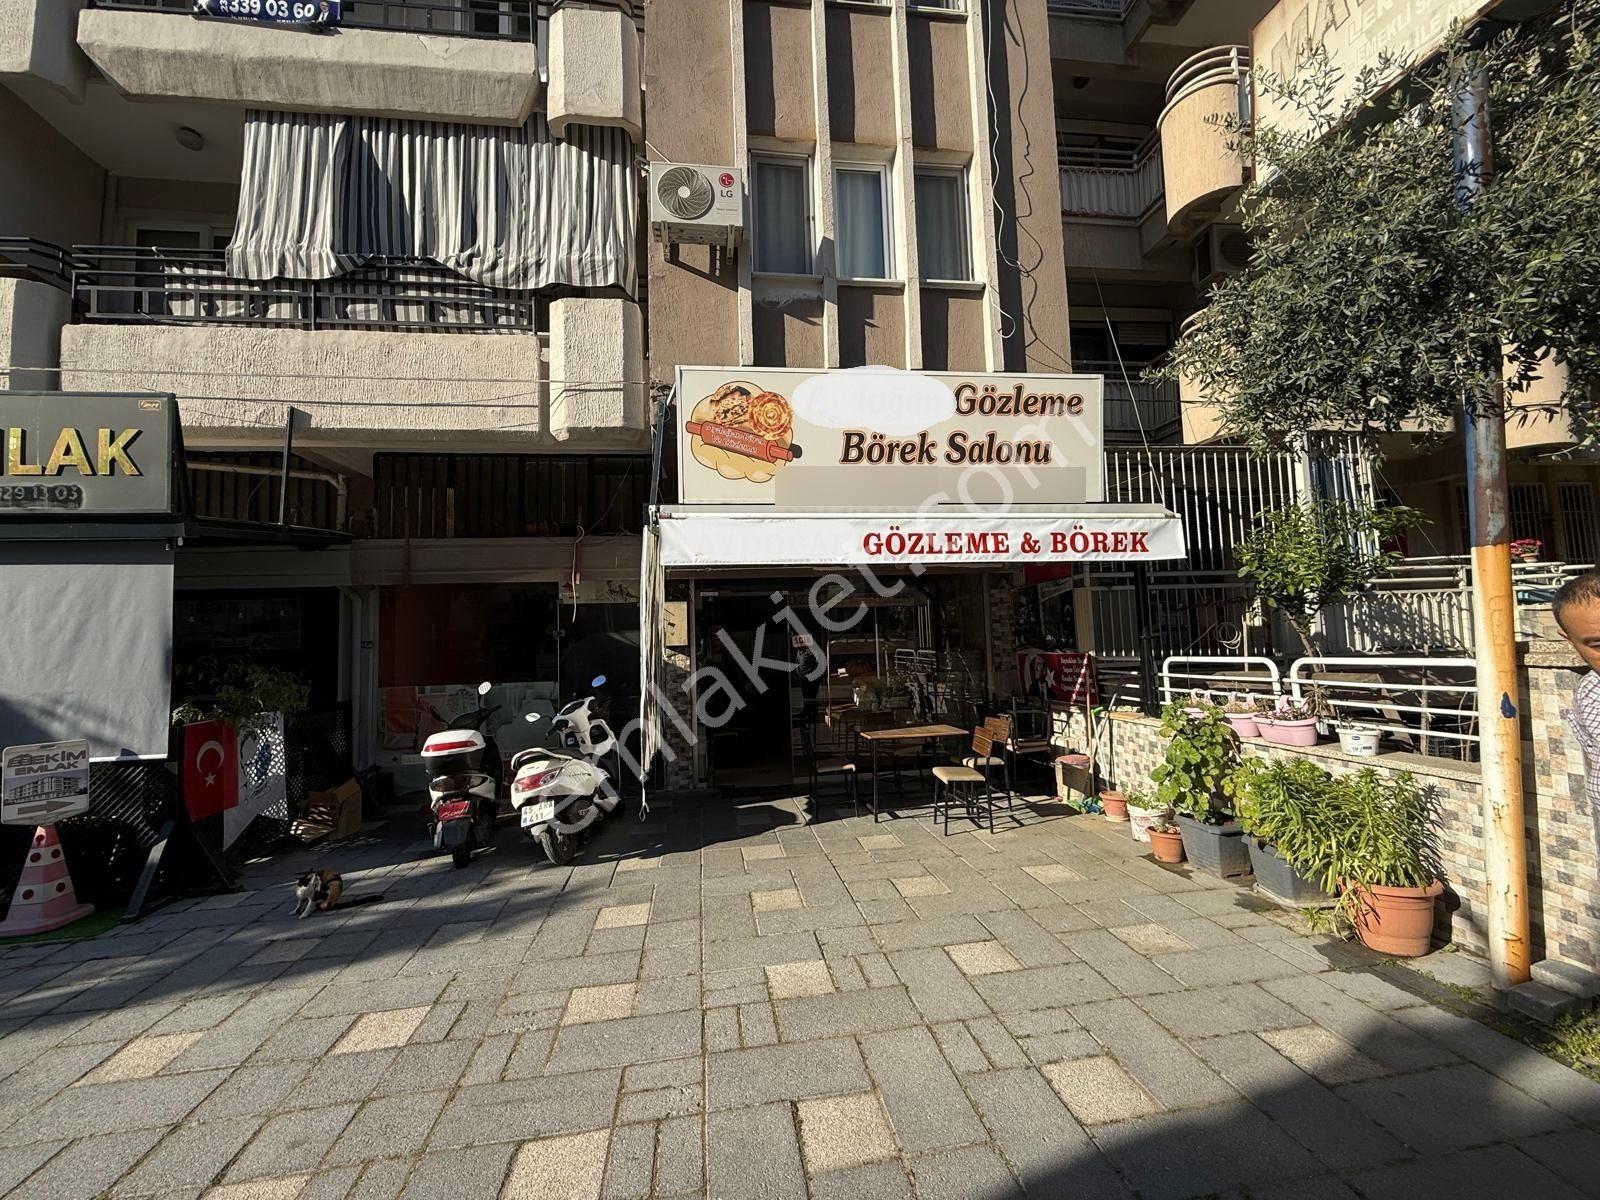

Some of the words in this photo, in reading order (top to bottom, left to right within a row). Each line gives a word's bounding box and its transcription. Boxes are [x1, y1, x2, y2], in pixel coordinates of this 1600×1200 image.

[229, 0, 260, 14] 339
[265, 0, 289, 17] 03
[293, 2, 315, 18] 60
[720, 190, 733, 198] LG
[955, 383, 1084, 416] Gözleme
[0, 427, 143, 476] LAK
[839, 431, 937, 465] Börek
[945, 431, 1052, 465] Salonu
[862, 525, 1010, 556] GÖZLEME
[1020, 532, 1041, 554] &
[1050, 525, 1149, 553] BÖREK
[14, 760, 79, 776] EMLAK
